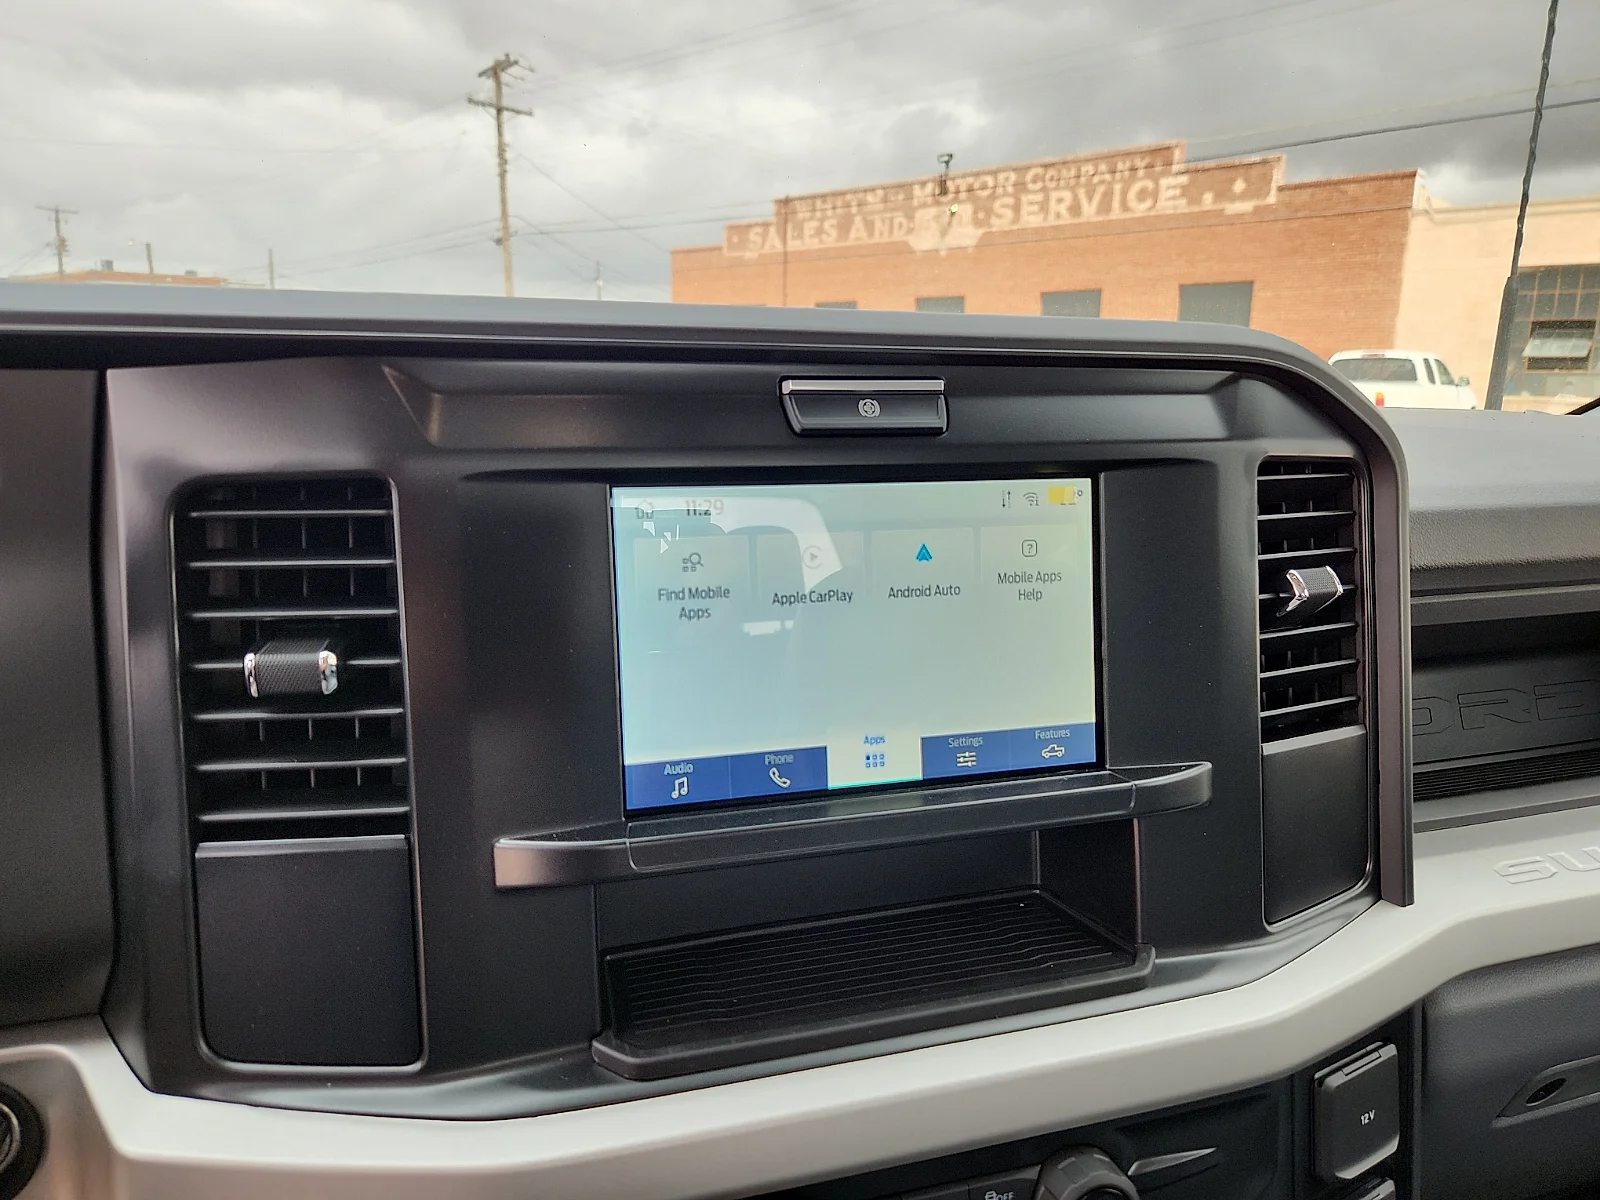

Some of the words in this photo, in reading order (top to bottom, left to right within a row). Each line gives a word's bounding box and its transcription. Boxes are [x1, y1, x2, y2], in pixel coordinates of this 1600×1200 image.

[912, 170, 1017, 206] MOTOR
[1024, 156, 1150, 191] COMPANY
[746, 217, 838, 250] SALES
[850, 213, 907, 242] AND
[989, 175, 1190, 230] SERVICE
[684, 499, 724, 516] 11:29
[997, 571, 1034, 584] Mobile
[1035, 570, 1062, 585] Apps
[657, 587, 686, 602] Find
[688, 585, 731, 601] Mobile
[771, 592, 808, 607] Apple
[809, 589, 854, 605] CarPlay
[887, 585, 932, 599] Android
[933, 584, 961, 597] Auto
[1018, 588, 1043, 602] Help
[678, 605, 712, 621] Apps
[863, 735, 886, 746] Apps
[1034, 728, 1070, 740] Features
[948, 736, 984, 748] Settings
[764, 753, 794, 766] Phone
[663, 762, 694, 776] Audio
